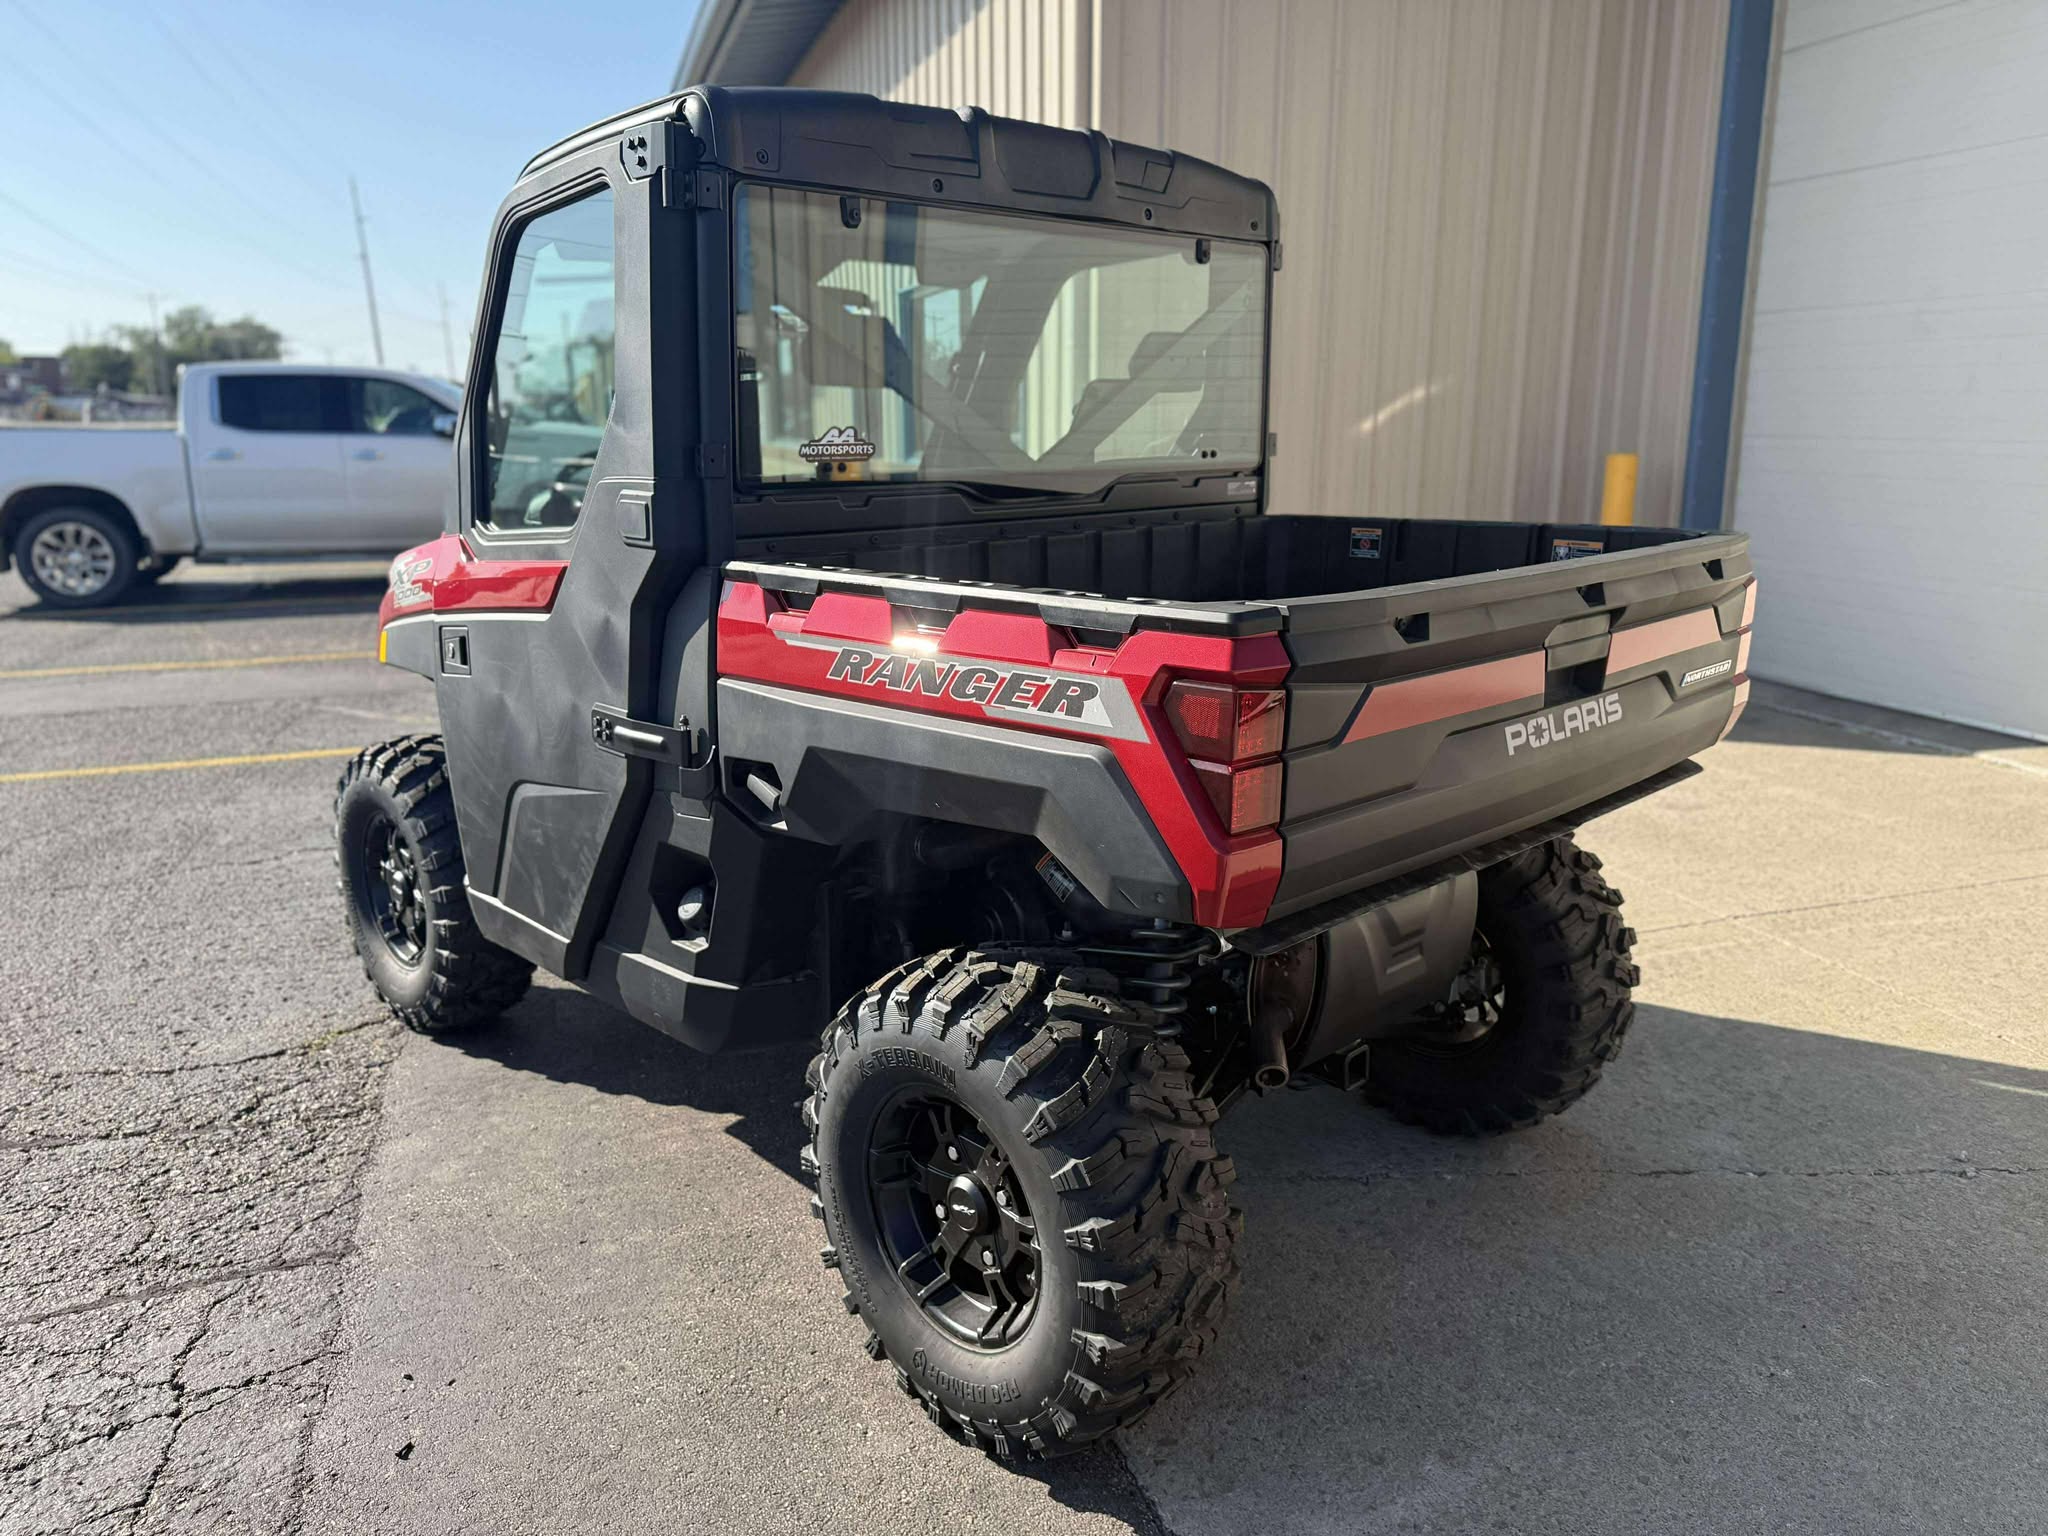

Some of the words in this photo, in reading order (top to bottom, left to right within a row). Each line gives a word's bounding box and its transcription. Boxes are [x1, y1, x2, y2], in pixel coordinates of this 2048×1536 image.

[801, 445, 873, 455] MOTORSPORTS
[395, 586, 421, 601] 000
[827, 647, 1100, 718] RANGER
[1684, 661, 1730, 685] NORTHSTAR
[1505, 693, 1622, 755] POLARIS
[855, 1046, 957, 1089] X-TERRAIN
[928, 1363, 987, 1404] ARMOR
[991, 1378, 1022, 1405] PRO
